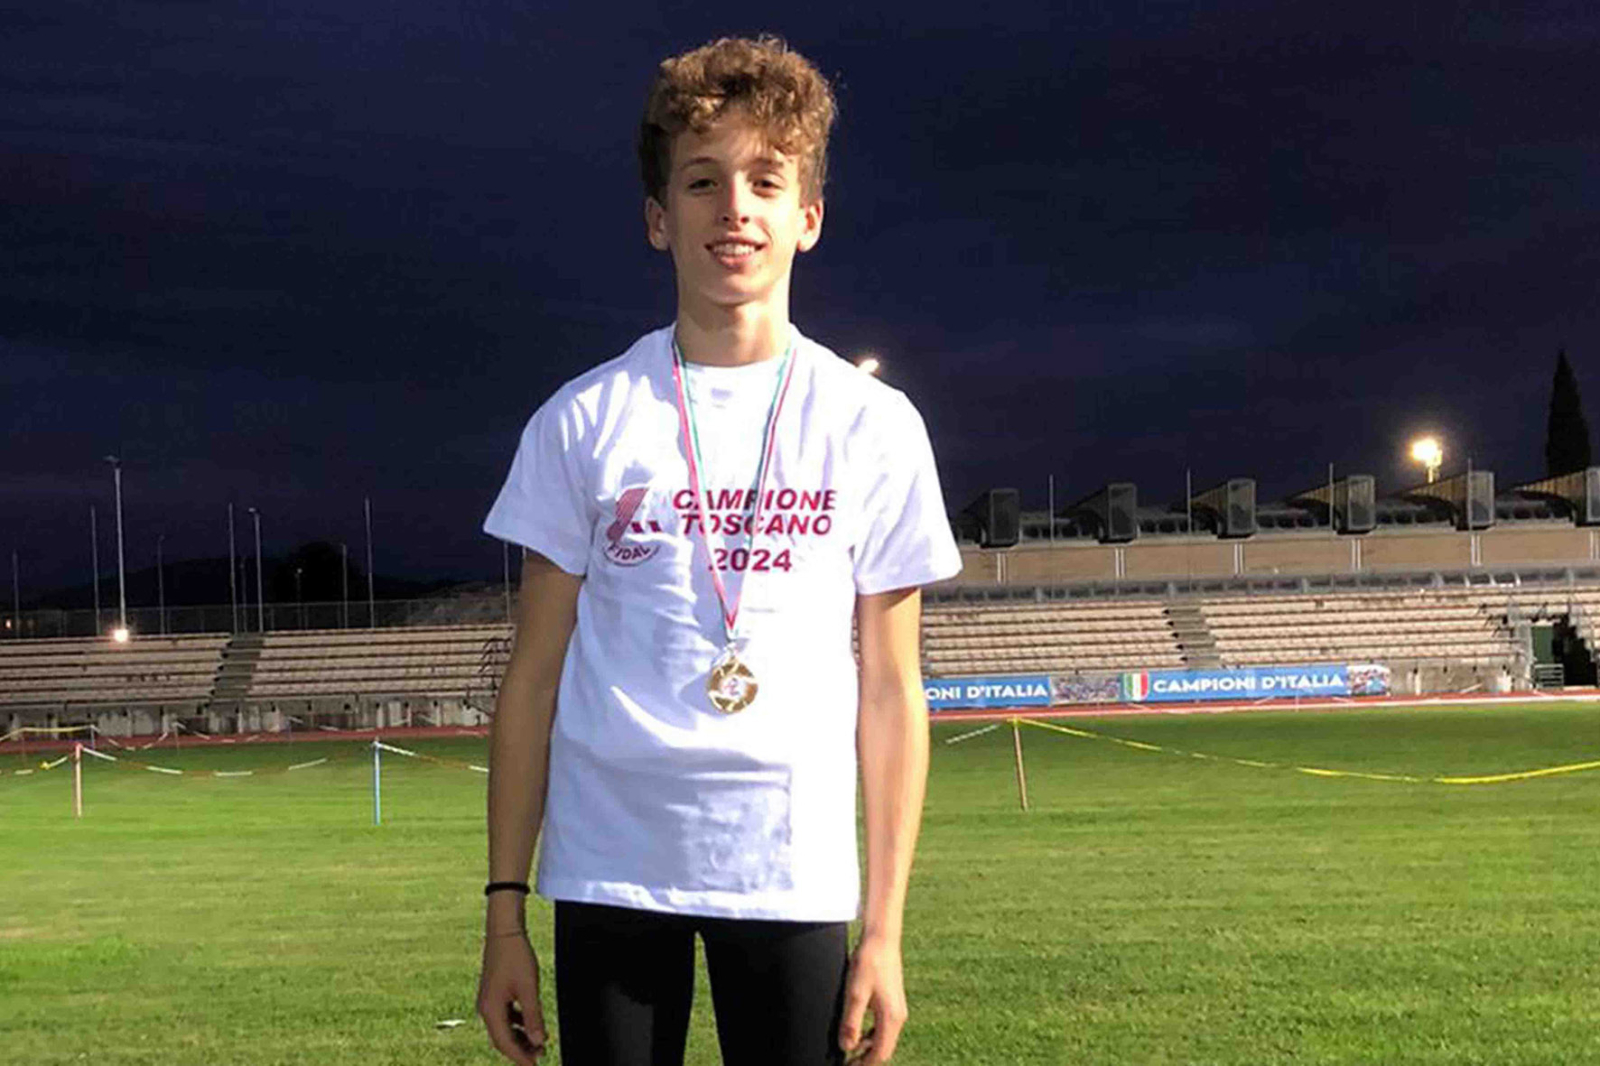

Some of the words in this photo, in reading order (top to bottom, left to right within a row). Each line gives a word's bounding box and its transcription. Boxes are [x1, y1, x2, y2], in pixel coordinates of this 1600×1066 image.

[672, 488, 837, 511] CAMPIONE
[681, 513, 832, 536] TOSCANO
[708, 547, 793, 572] 2024
[966, 683, 1049, 699] D'ITALIA
[1152, 676, 1256, 693] CAMPIONI
[1262, 674, 1345, 690] D'ITALIA
